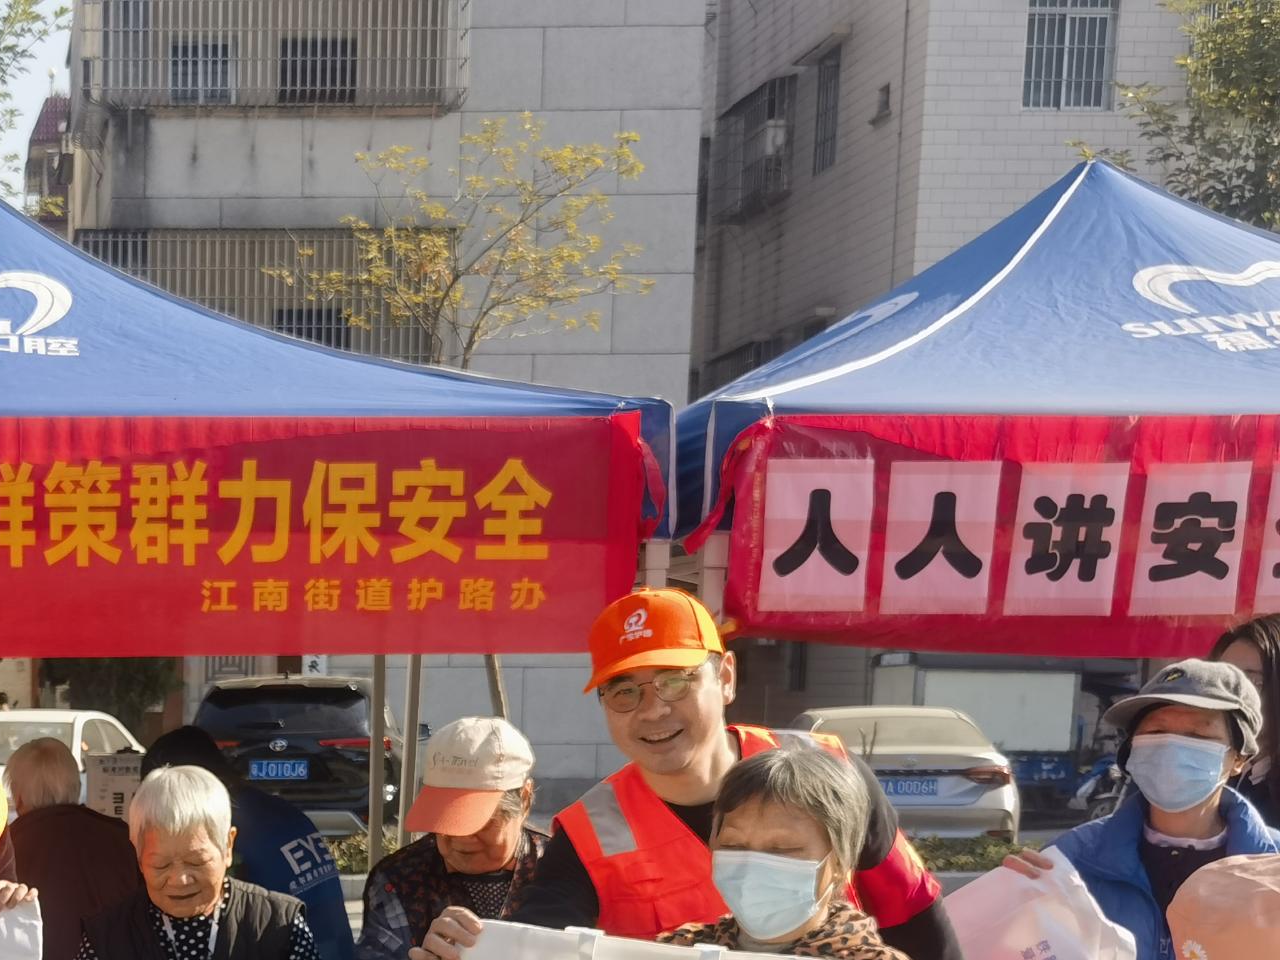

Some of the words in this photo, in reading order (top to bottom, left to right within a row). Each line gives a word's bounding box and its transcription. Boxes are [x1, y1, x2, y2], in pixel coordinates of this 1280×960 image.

[1121, 311, 1280, 338] SUIW
[1201, 325, 1280, 353] 穗
[772, 489, 1280, 583] 人人讲安
[200, 577, 547, 614] 江南街道护路办
